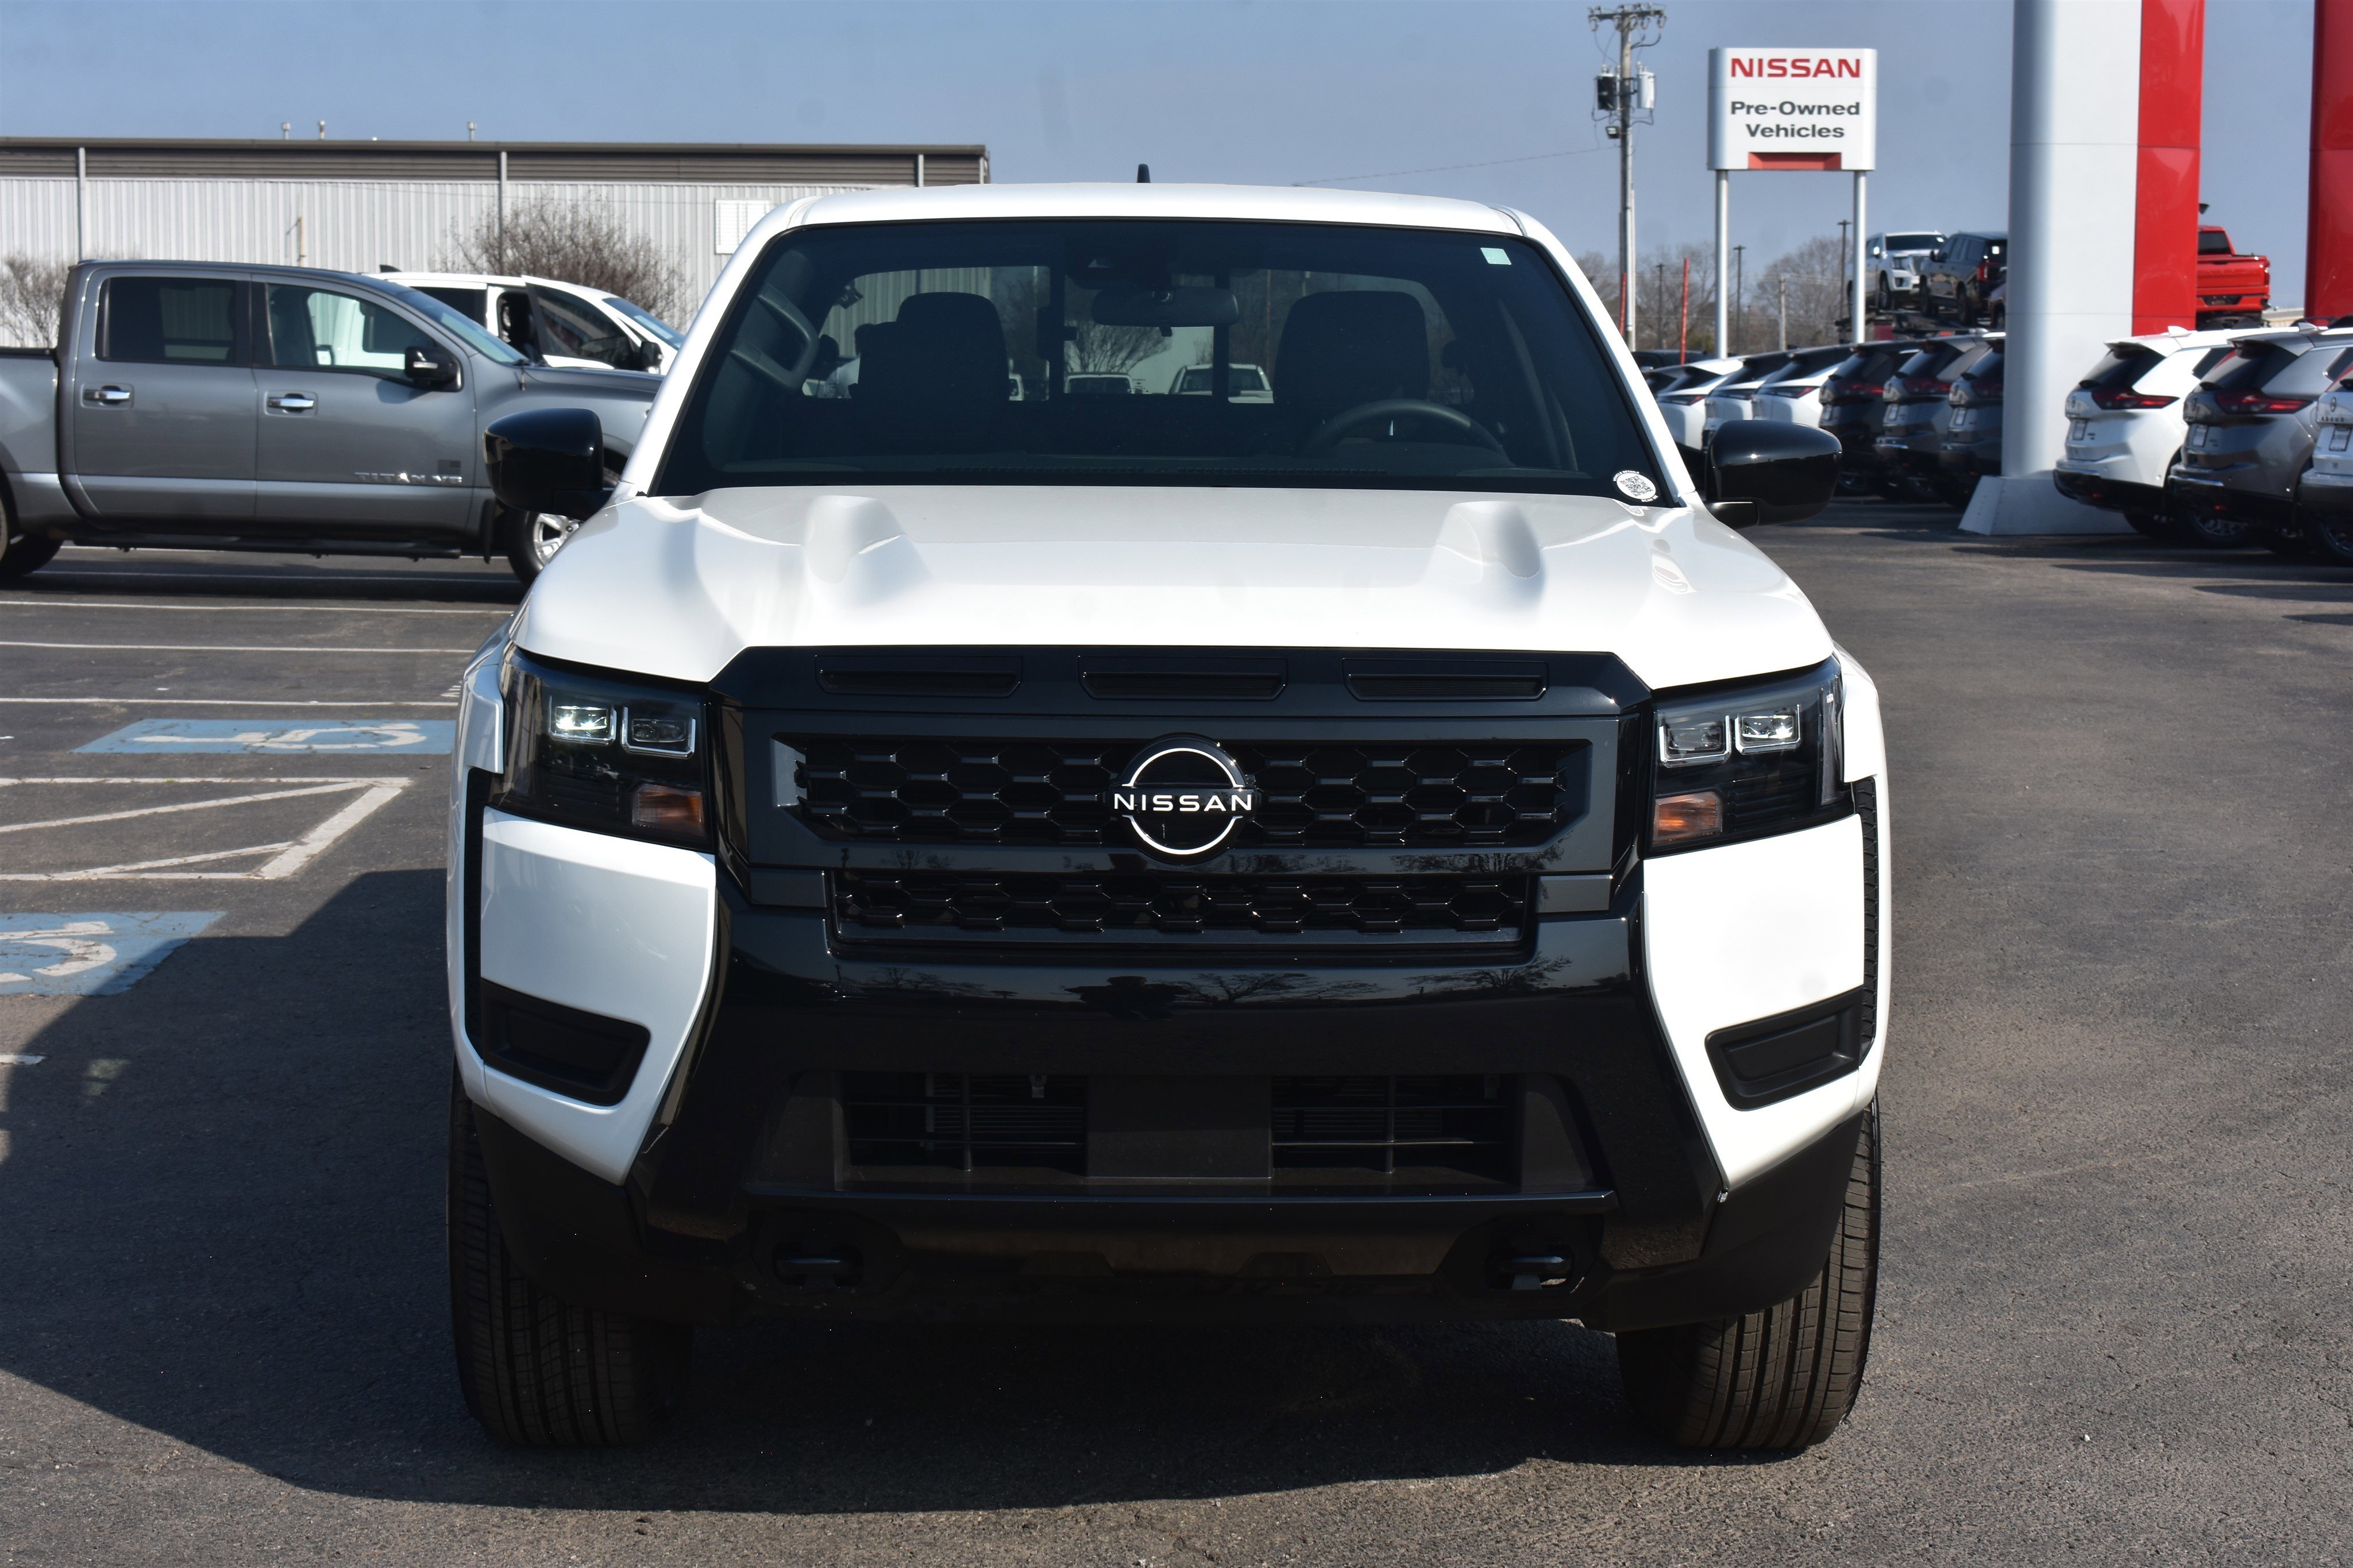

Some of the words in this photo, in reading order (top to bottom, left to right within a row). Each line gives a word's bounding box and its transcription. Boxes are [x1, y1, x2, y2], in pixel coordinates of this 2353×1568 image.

[1731, 58, 1860, 78] NISSAN
[1731, 101, 1860, 115] Pre-Owned
[1746, 124, 1845, 137] Vehicles
[1114, 793, 1252, 812] NISSAN
